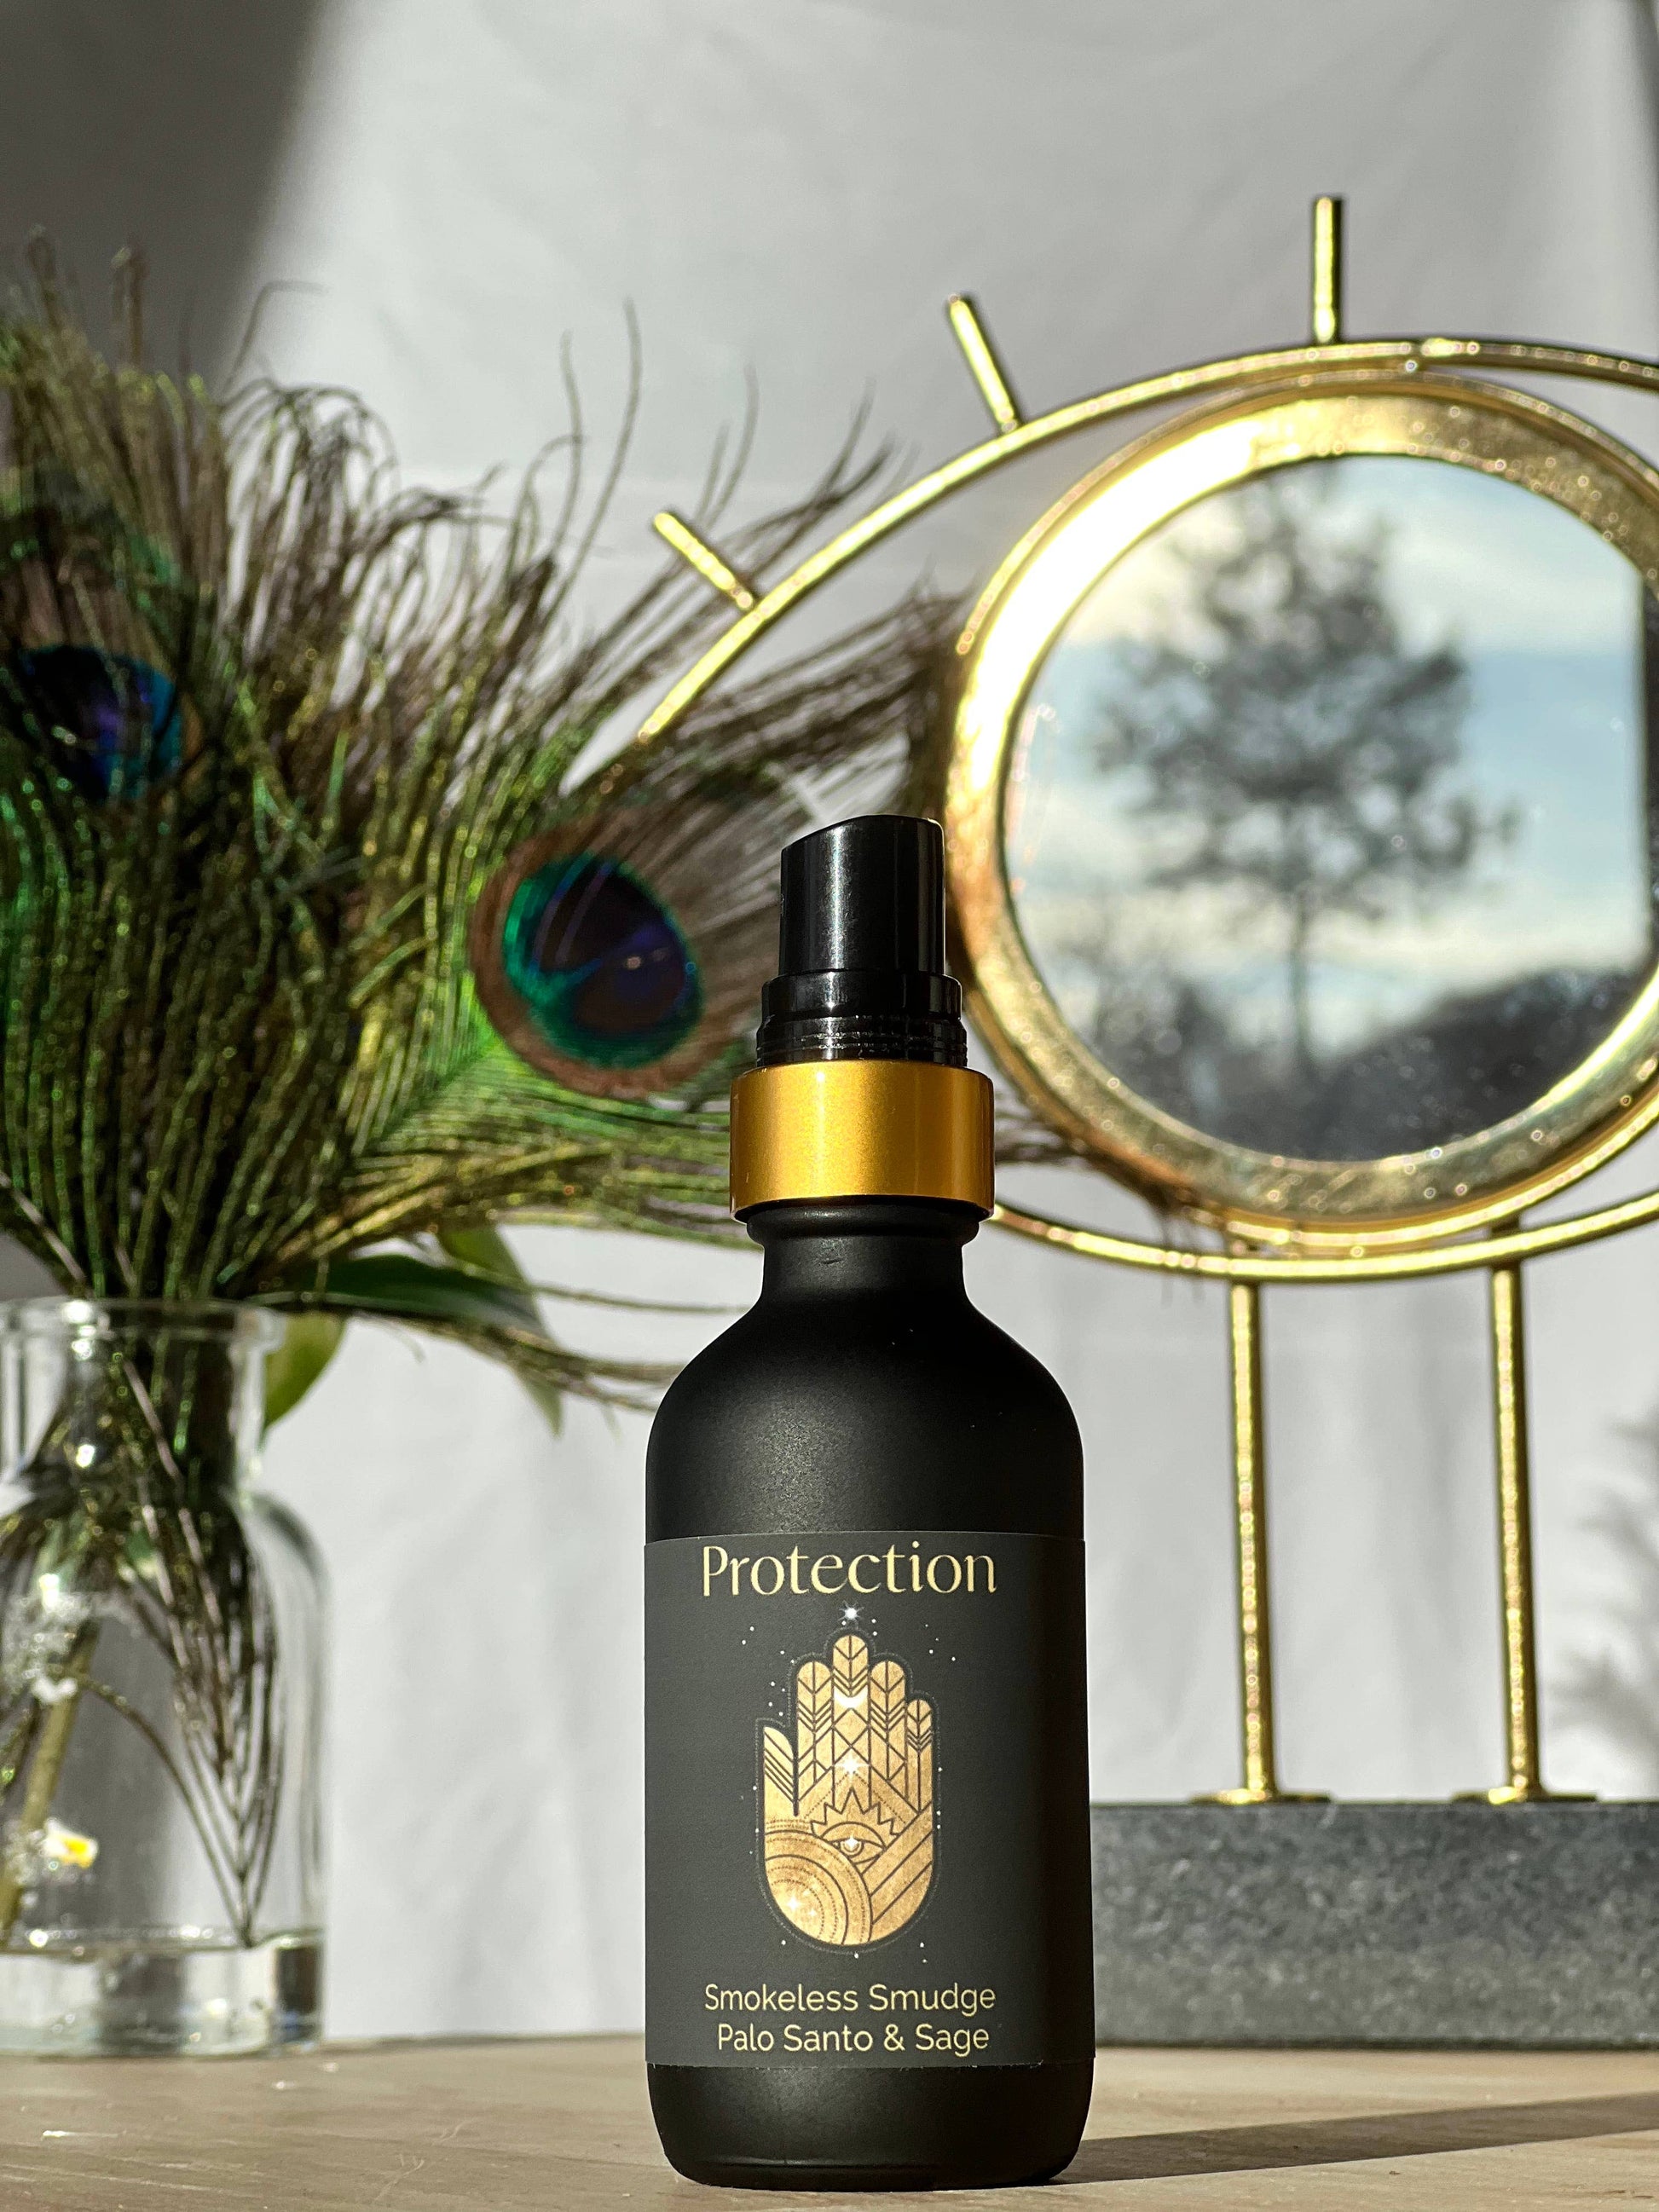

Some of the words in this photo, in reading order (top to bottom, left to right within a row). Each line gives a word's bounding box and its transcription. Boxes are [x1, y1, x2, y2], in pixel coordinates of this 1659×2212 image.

[702, 1540, 997, 1597] Protection
[704, 1983, 858, 2013] Smokeless
[869, 1982, 996, 2017] Smudge
[718, 2024, 774, 2052] Palo
[783, 2025, 873, 2053] Santo
[884, 2024, 905, 2052] &
[915, 2024, 990, 2057] Sage
